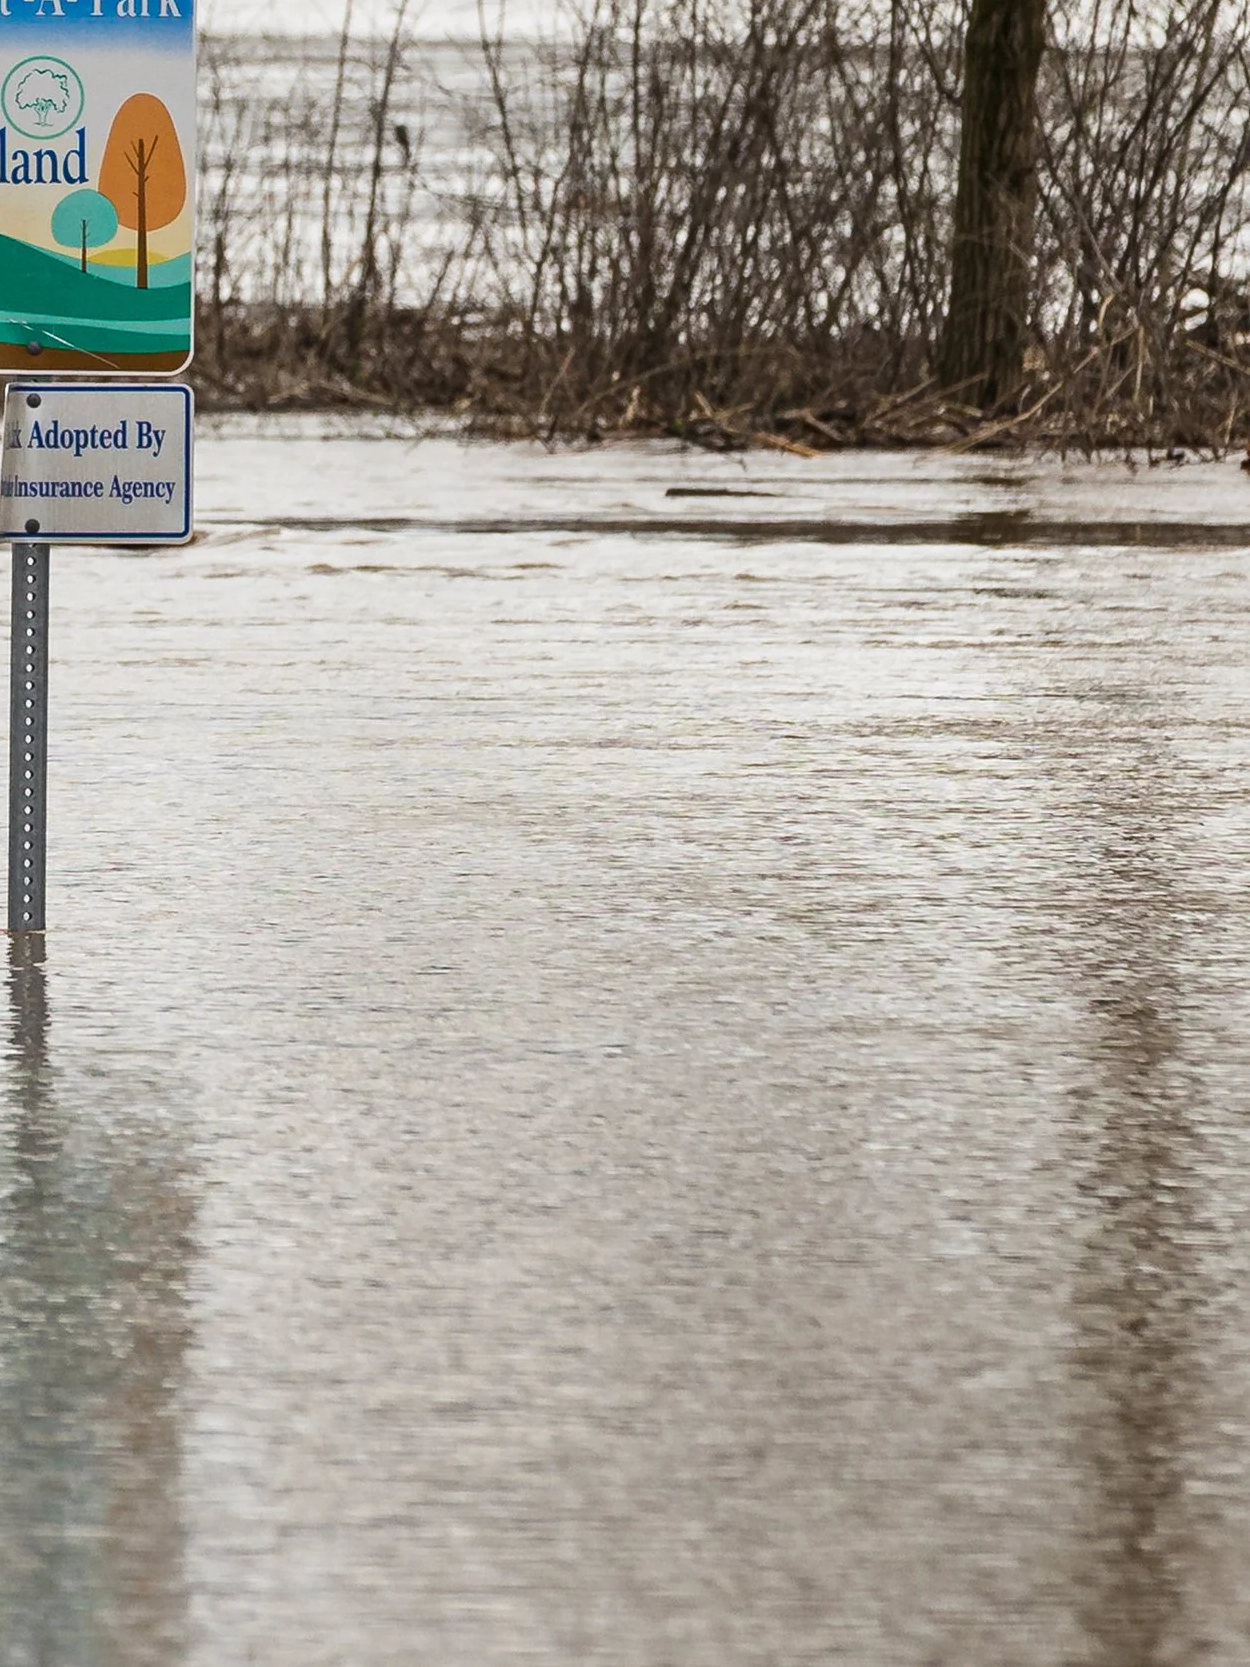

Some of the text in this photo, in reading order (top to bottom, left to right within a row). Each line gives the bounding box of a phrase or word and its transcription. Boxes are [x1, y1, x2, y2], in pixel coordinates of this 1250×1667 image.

[27, 420, 128, 456] Adopted
[136, 421, 166, 457] By
[14, 475, 104, 498] Insurance
[109, 475, 176, 504] Agency
